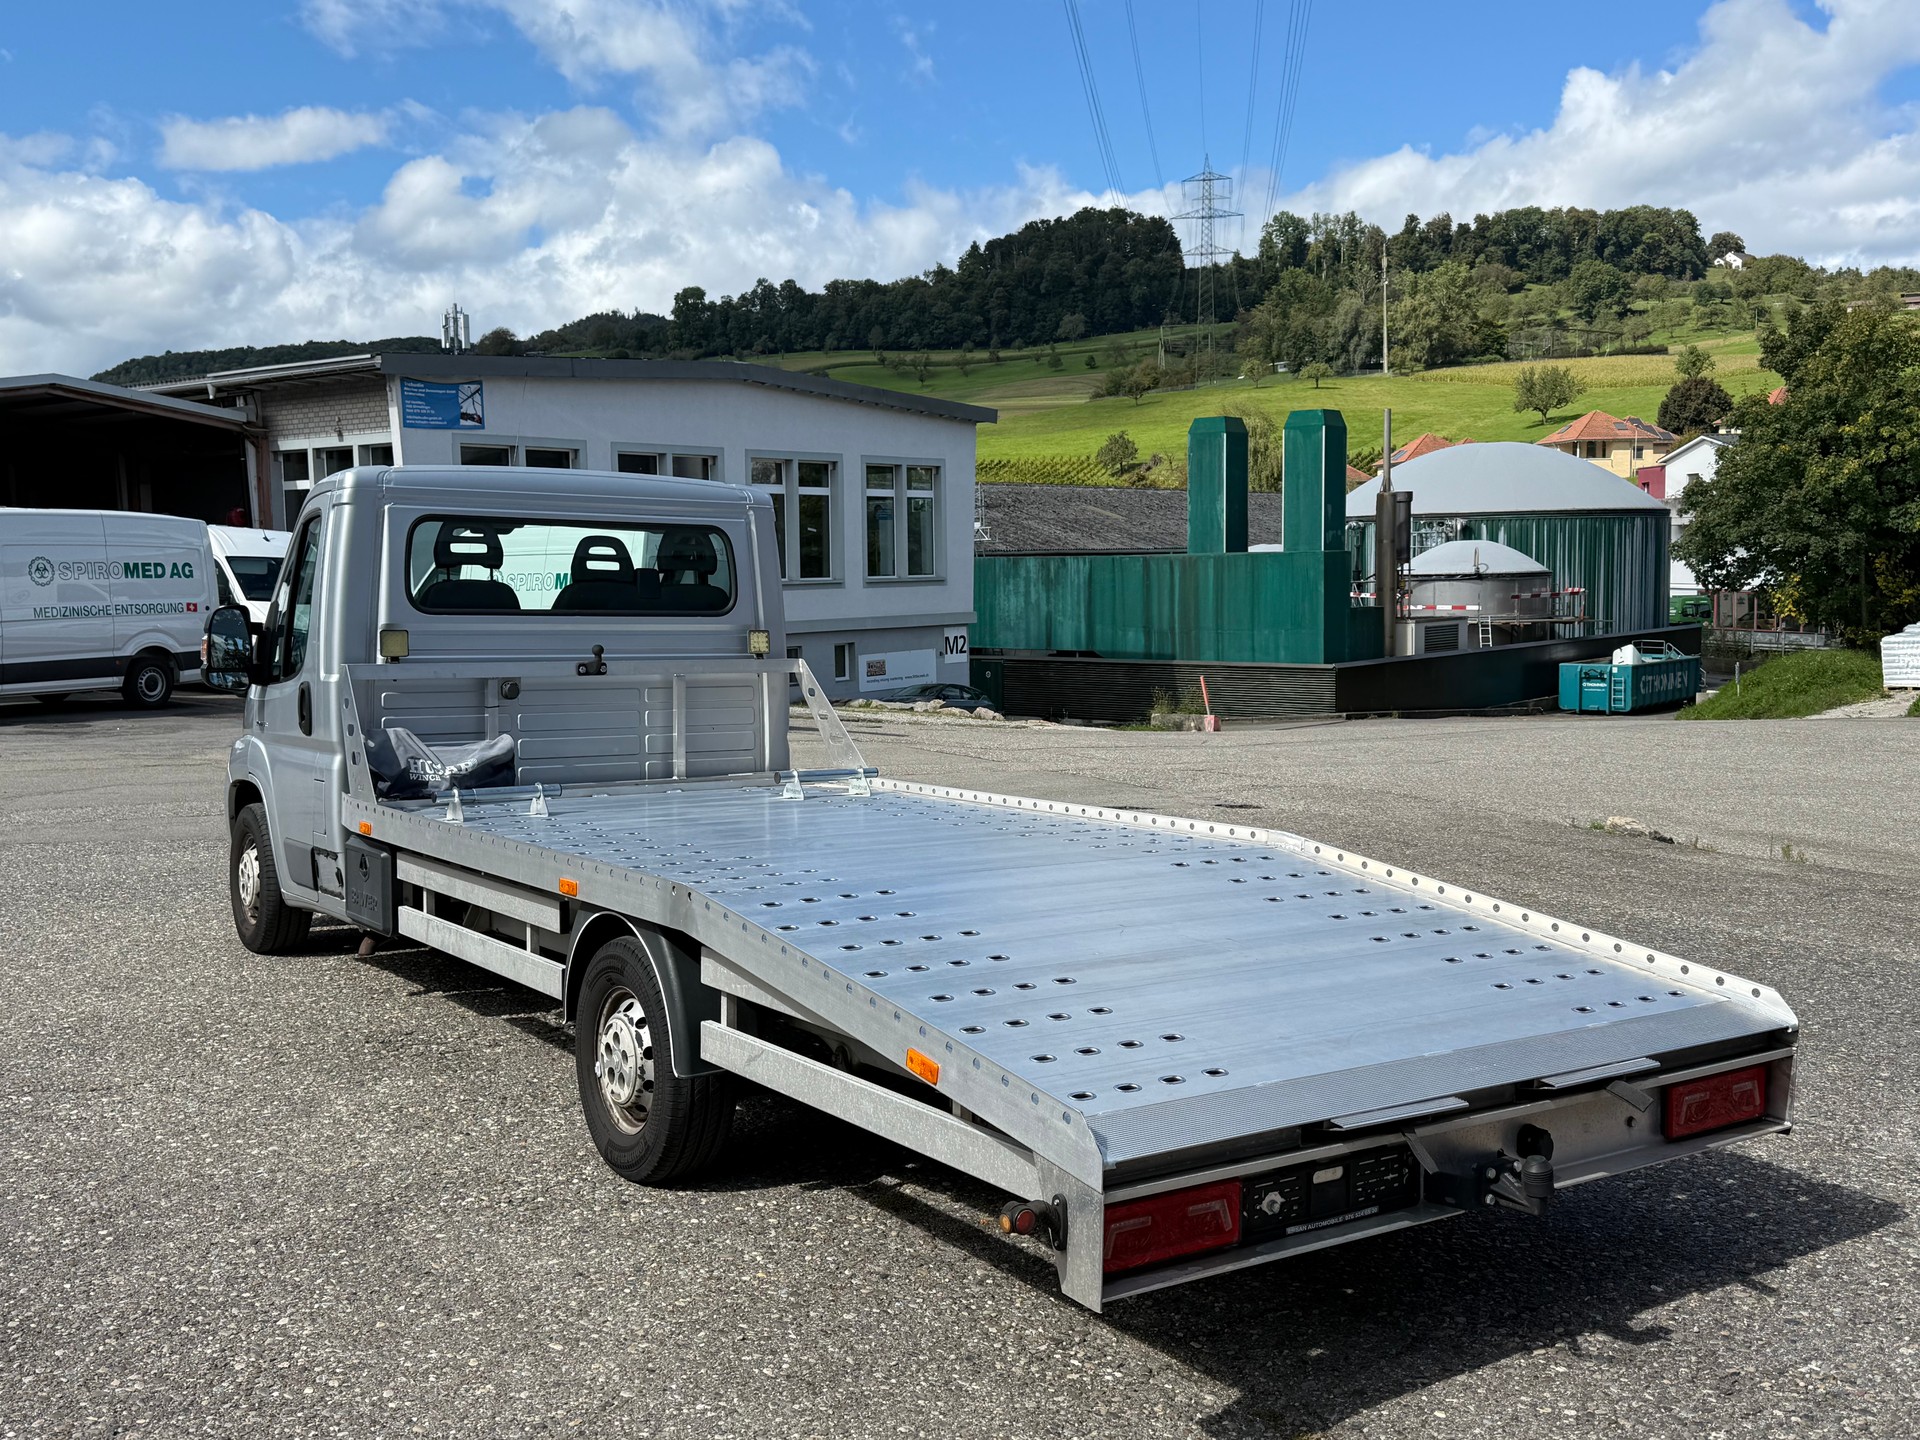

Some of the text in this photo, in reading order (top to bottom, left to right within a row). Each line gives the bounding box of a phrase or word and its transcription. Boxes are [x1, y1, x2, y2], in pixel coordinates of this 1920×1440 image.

[58, 561, 194, 580] SPIROMED AG
[506, 572, 574, 592] SPIROM
[33, 602, 184, 619] MEDIZINISCHE ENTSORGUNG
[944, 634, 967, 655] M2
